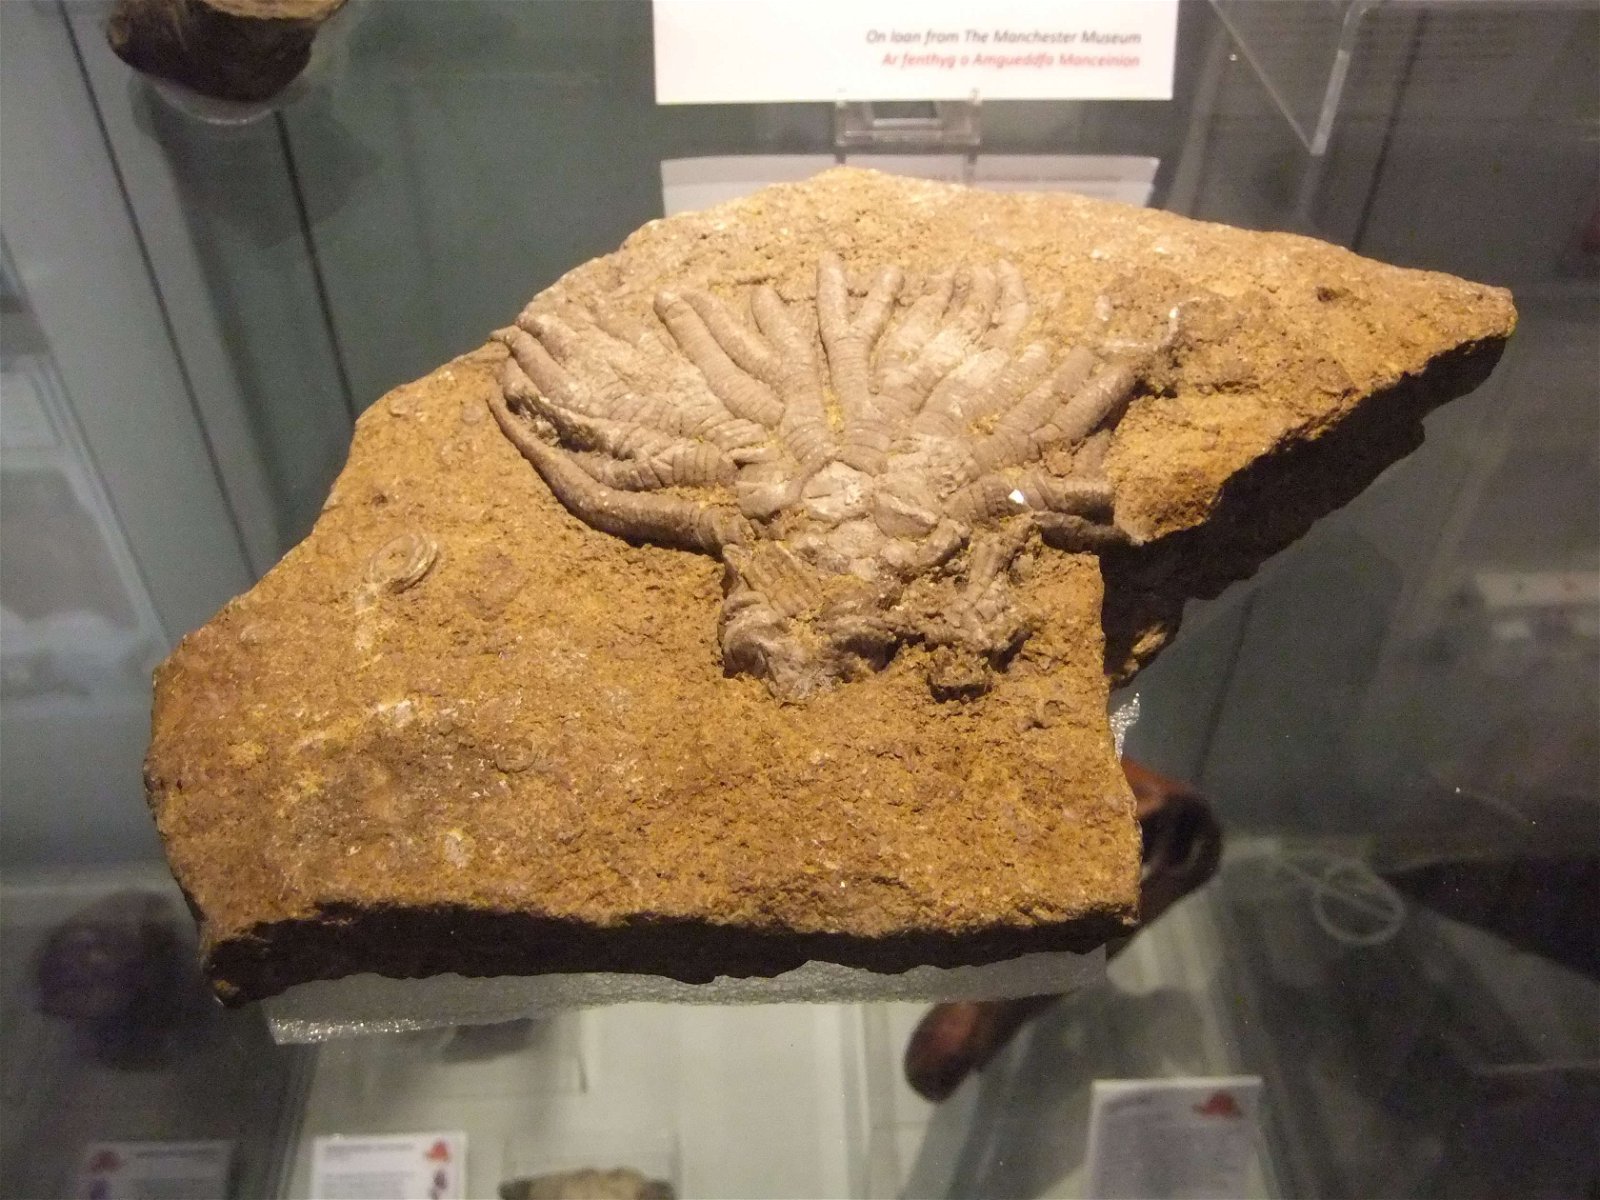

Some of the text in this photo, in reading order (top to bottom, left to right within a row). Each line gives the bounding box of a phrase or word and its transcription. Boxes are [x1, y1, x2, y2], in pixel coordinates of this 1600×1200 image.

[866, 28, 1142, 47] On loan from The Manchester Museum
[882, 52, 1140, 69] Ar fenthyg o Amgueddfa Manceinion
